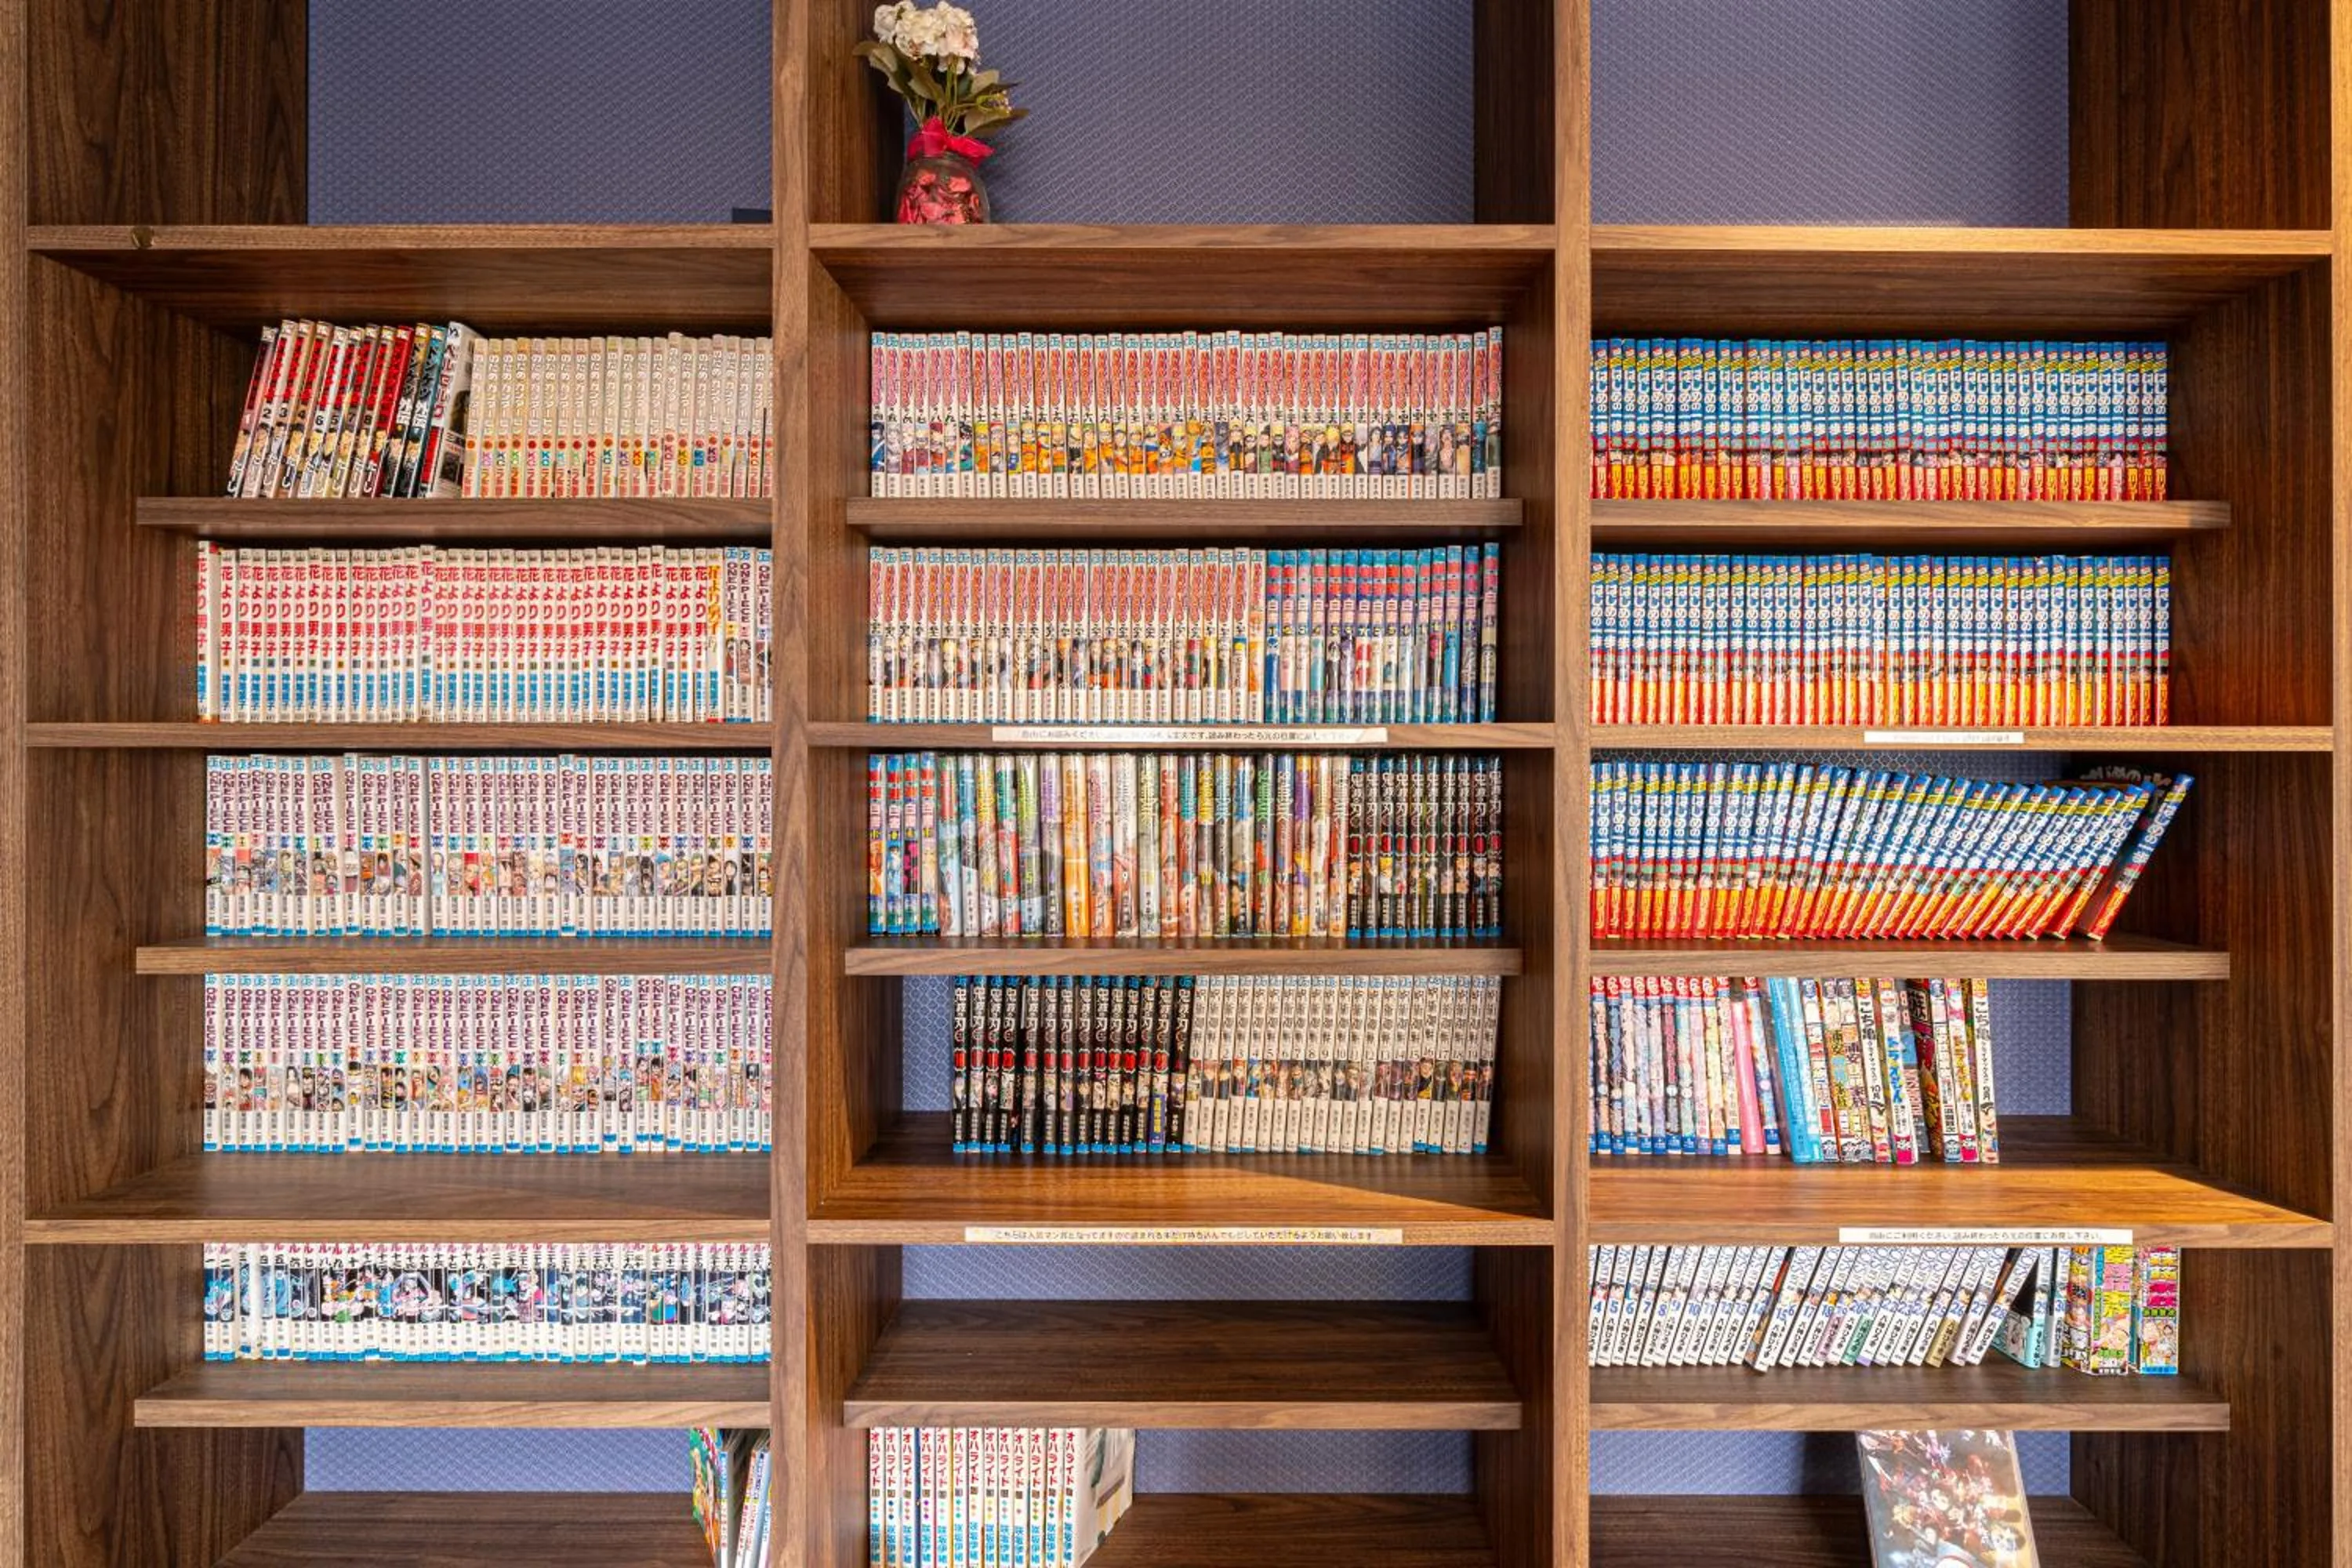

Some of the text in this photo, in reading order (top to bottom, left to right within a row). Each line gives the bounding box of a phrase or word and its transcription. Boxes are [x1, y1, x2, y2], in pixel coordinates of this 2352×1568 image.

[263, 408, 271, 418] 2
[279, 408, 288, 418] 3
[297, 409, 307, 419] 4
[315, 416, 323, 425] 6
[331, 416, 339, 425] 5
[349, 413, 357, 423] 7
[364, 415, 372, 425] 8
[739, 563, 750, 584] ONE
[221, 567, 233, 656] 花より男子
[252, 567, 264, 656] 花より男子
[267, 567, 280, 656] 花より男子
[309, 564, 321, 655] 花より男子
[336, 567, 348, 656] 花より男子
[351, 567, 364, 656] 花より男子
[421, 561, 434, 651] 花より男子
[474, 568, 485, 657] 花より男子
[516, 568, 529, 658] 花より男子
[529, 568, 540, 657] 花より男子
[543, 568, 555, 658] 花より男子
[584, 566, 595, 655] 花より男子
[597, 565, 608, 655] 花より男子
[597, 566, 608, 655] 花より男子
[623, 568, 634, 657] 花より男子
[651, 564, 662, 653] 花より男子
[666, 568, 678, 657] 花より男子
[680, 567, 691, 656] 花より男子
[279, 773, 291, 795] ONE
[377, 775, 388, 796] ONE
[408, 773, 420, 795] ONE
[576, 774, 586, 796] ONE
[224, 989, 236, 1010] ONE
[241, 989, 252, 1010] ONE
[270, 989, 282, 1010] ONE
[332, 989, 343, 1011] ONE
[396, 989, 407, 1010] ONE
[442, 989, 453, 1011] ONE
[459, 989, 470, 1011] ONE
[621, 989, 633, 1011] ONE
[684, 988, 695, 1009] ONE
[870, 1428, 880, 1486] オハライド
[887, 1428, 895, 1486] オハライド
[921, 1428, 932, 1486] オハライド
[969, 1428, 979, 1486] オハライド
[985, 1428, 995, 1486] オハライド
[1031, 1428, 1041, 1486] オハライド
[1065, 1428, 1075, 1486] オハライド
